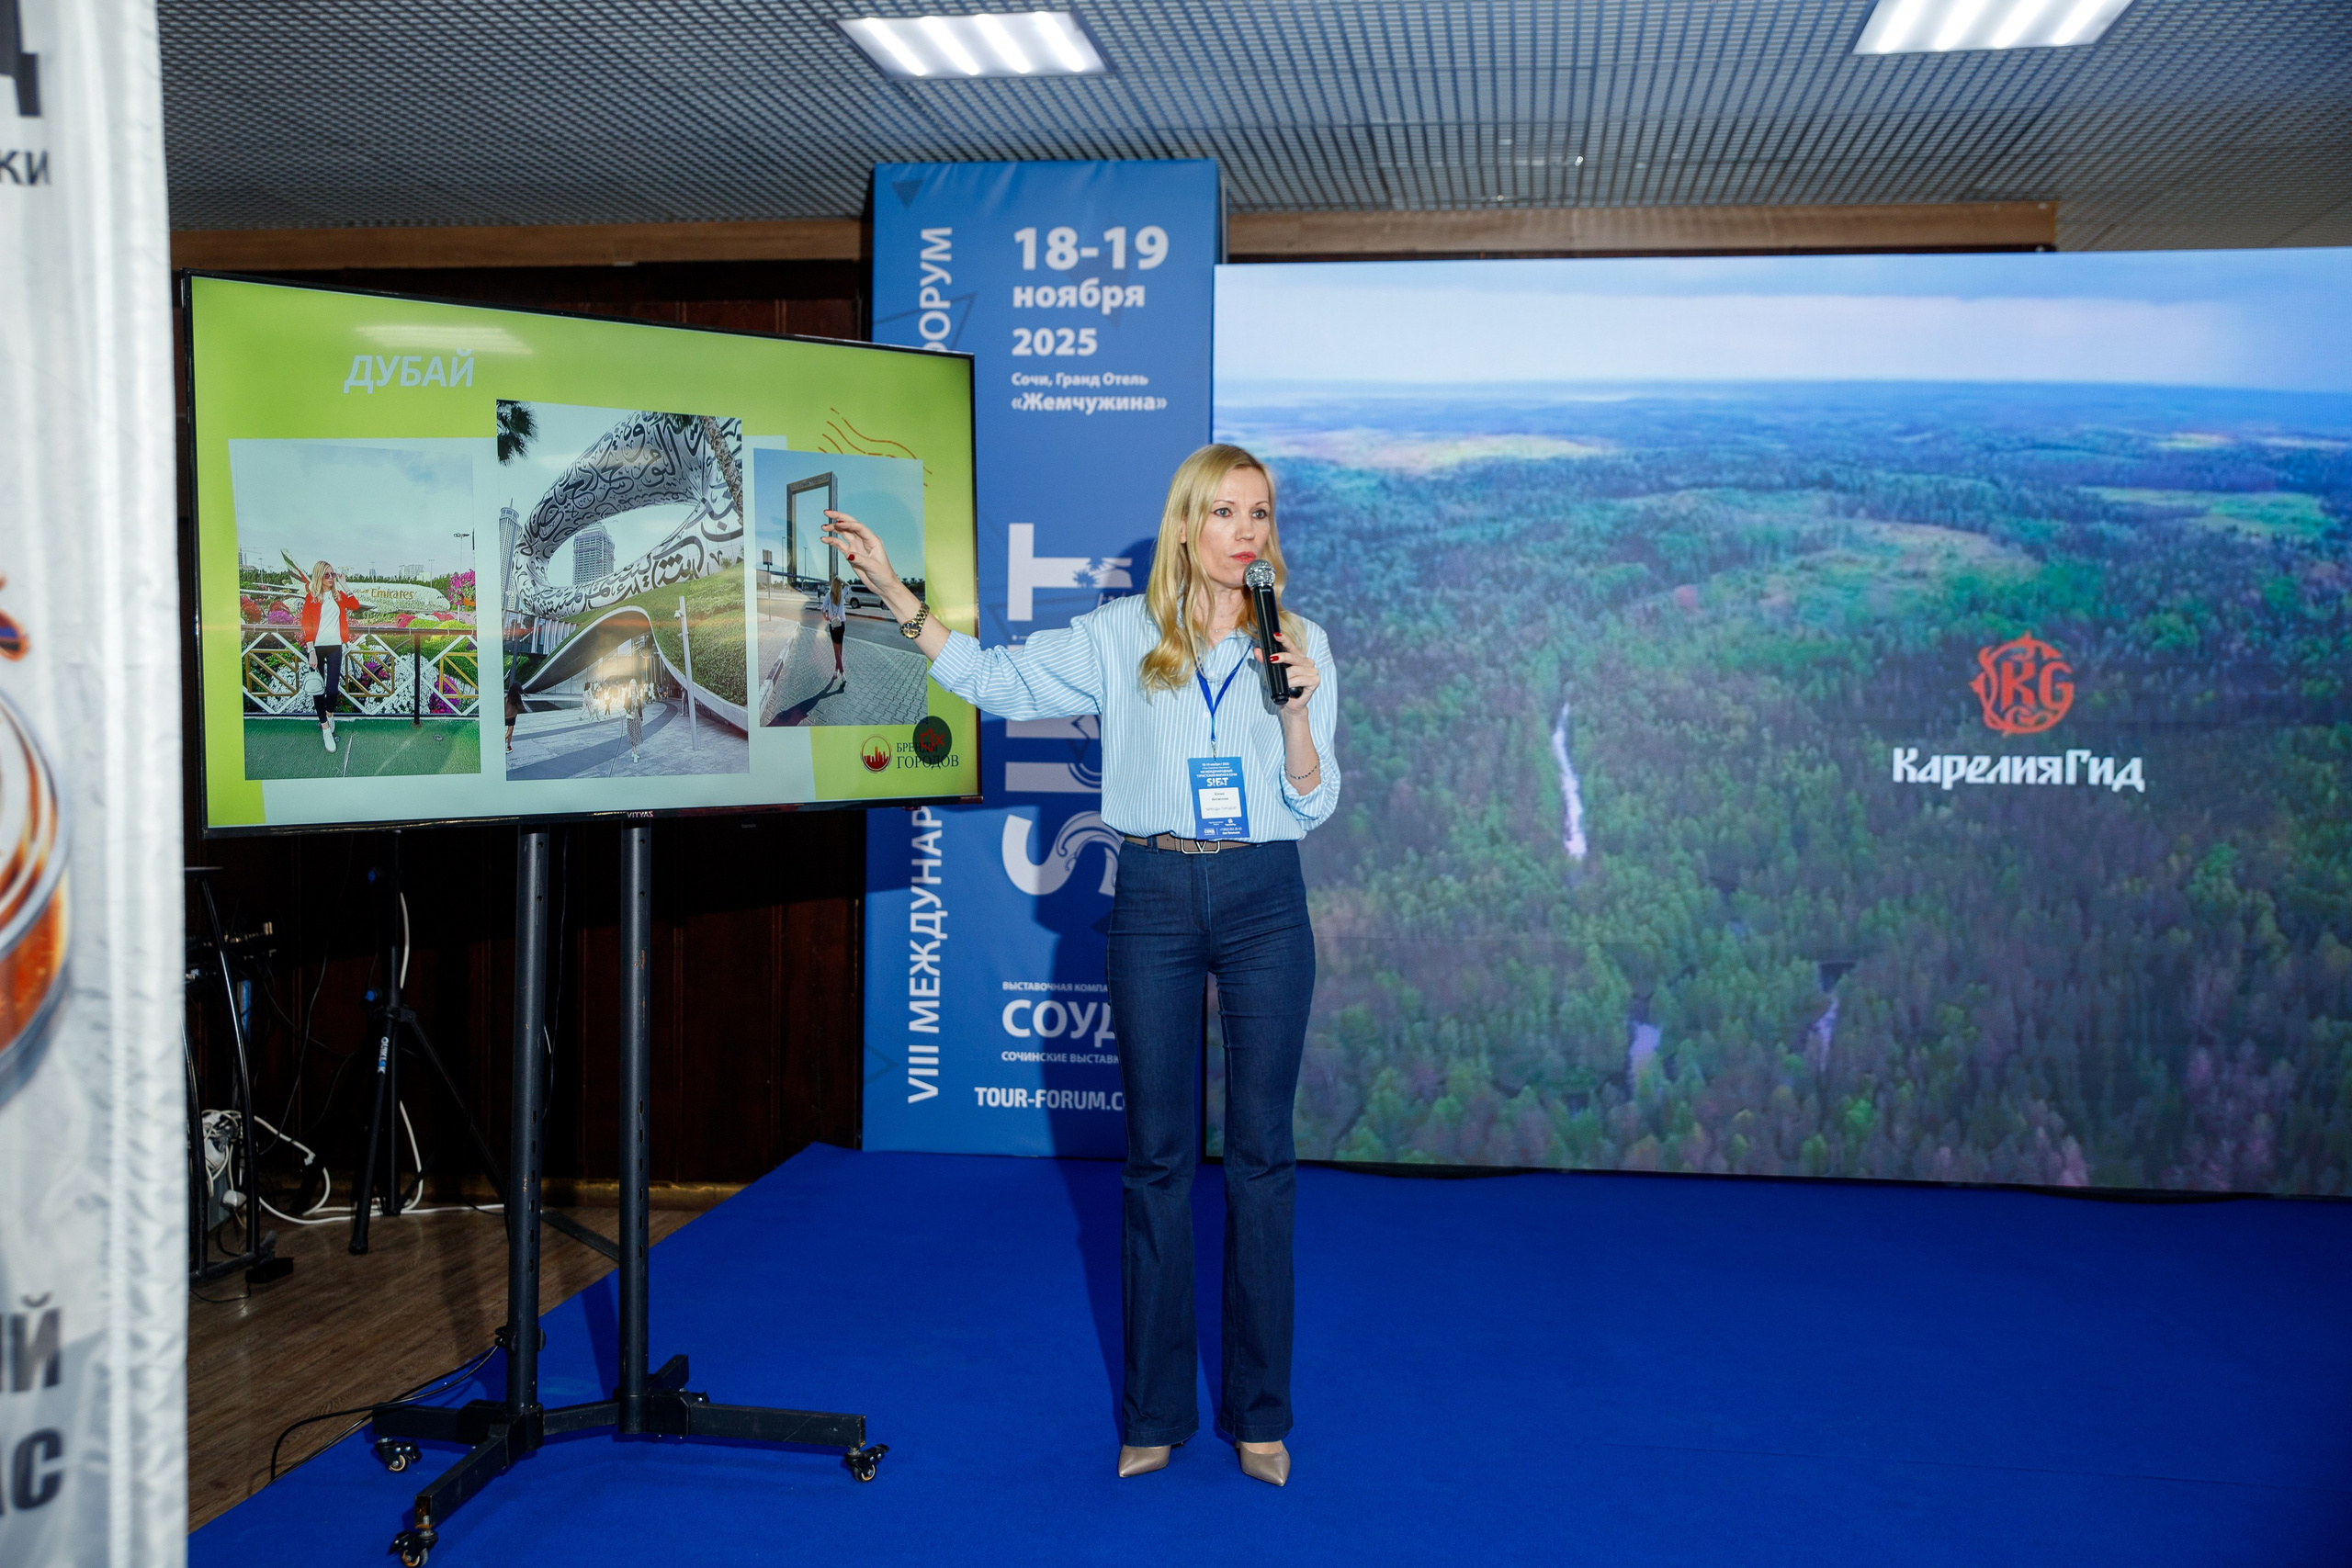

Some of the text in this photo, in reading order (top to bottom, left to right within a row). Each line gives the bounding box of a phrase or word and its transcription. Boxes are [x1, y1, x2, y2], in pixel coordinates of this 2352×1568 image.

[1013, 225, 1170, 271] 18-19
[919, 227, 953, 351] ОРУМ
[1012, 277, 1146, 315] ноября
[1011, 327, 1098, 356] 2025
[343, 347, 475, 395] ДУБАЙ
[1011, 371, 1149, 389] Сочи, Гранд Отель
[1011, 392, 1168, 416] «Жемчужина»
[371, 588, 415, 600] Emirates
[896, 754, 959, 771] ГОРОДОВ
[1893, 747, 2145, 793] КарелияГид
[1001, 981, 1072, 992] ВЫСТАВОЧНАЯ
[1001, 1051, 1068, 1063] СОЧИНСКИЕ
[908, 1045, 940, 1104] VIII
[974, 1087, 1125, 1111] TOUR-FORUM.C
